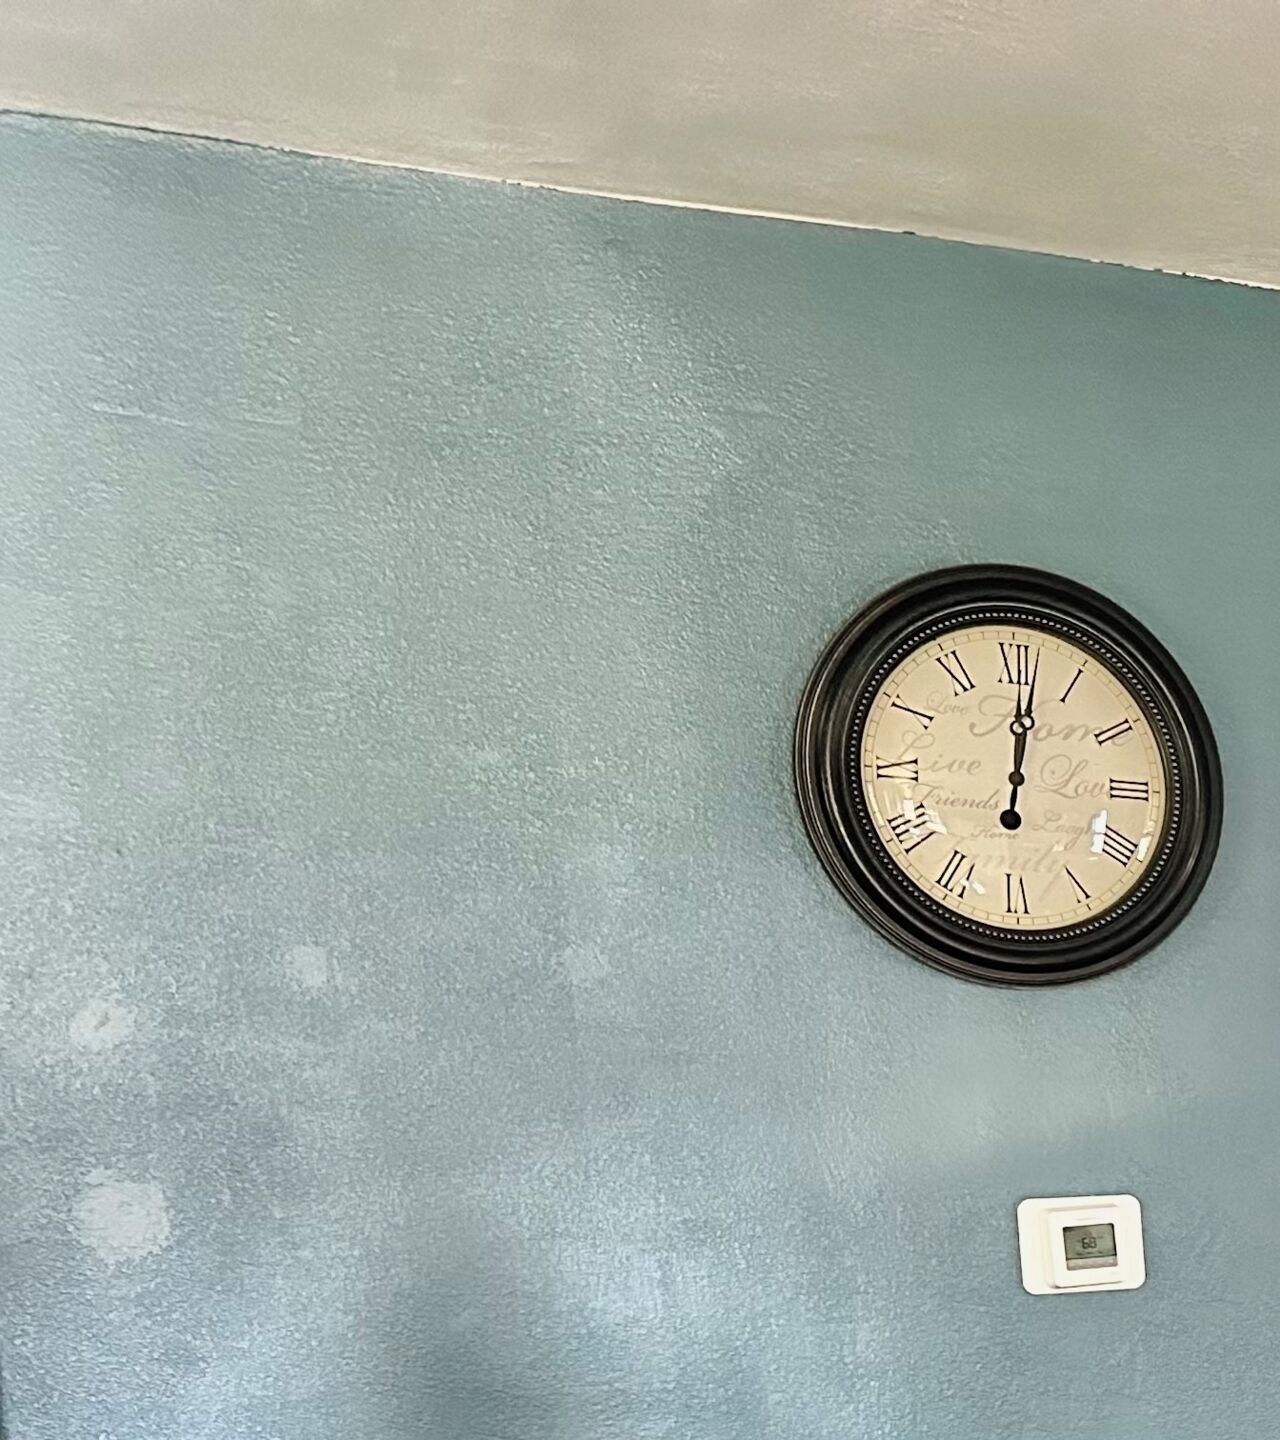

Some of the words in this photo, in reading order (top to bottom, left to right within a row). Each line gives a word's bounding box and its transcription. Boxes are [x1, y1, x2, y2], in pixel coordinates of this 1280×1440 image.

[935, 649, 976, 697] XI
[997, 641, 1030, 686] XII
[890, 694, 935, 731] X
[876, 756, 919, 783] IX
[1033, 754, 1112, 800] Lov
[1109, 777, 1149, 802] III
[908, 781, 1001, 811] Friends
[1032, 810, 1093, 850] Laug
[1003, 872, 1030, 915] VI
[1063, 863, 1092, 904] V
